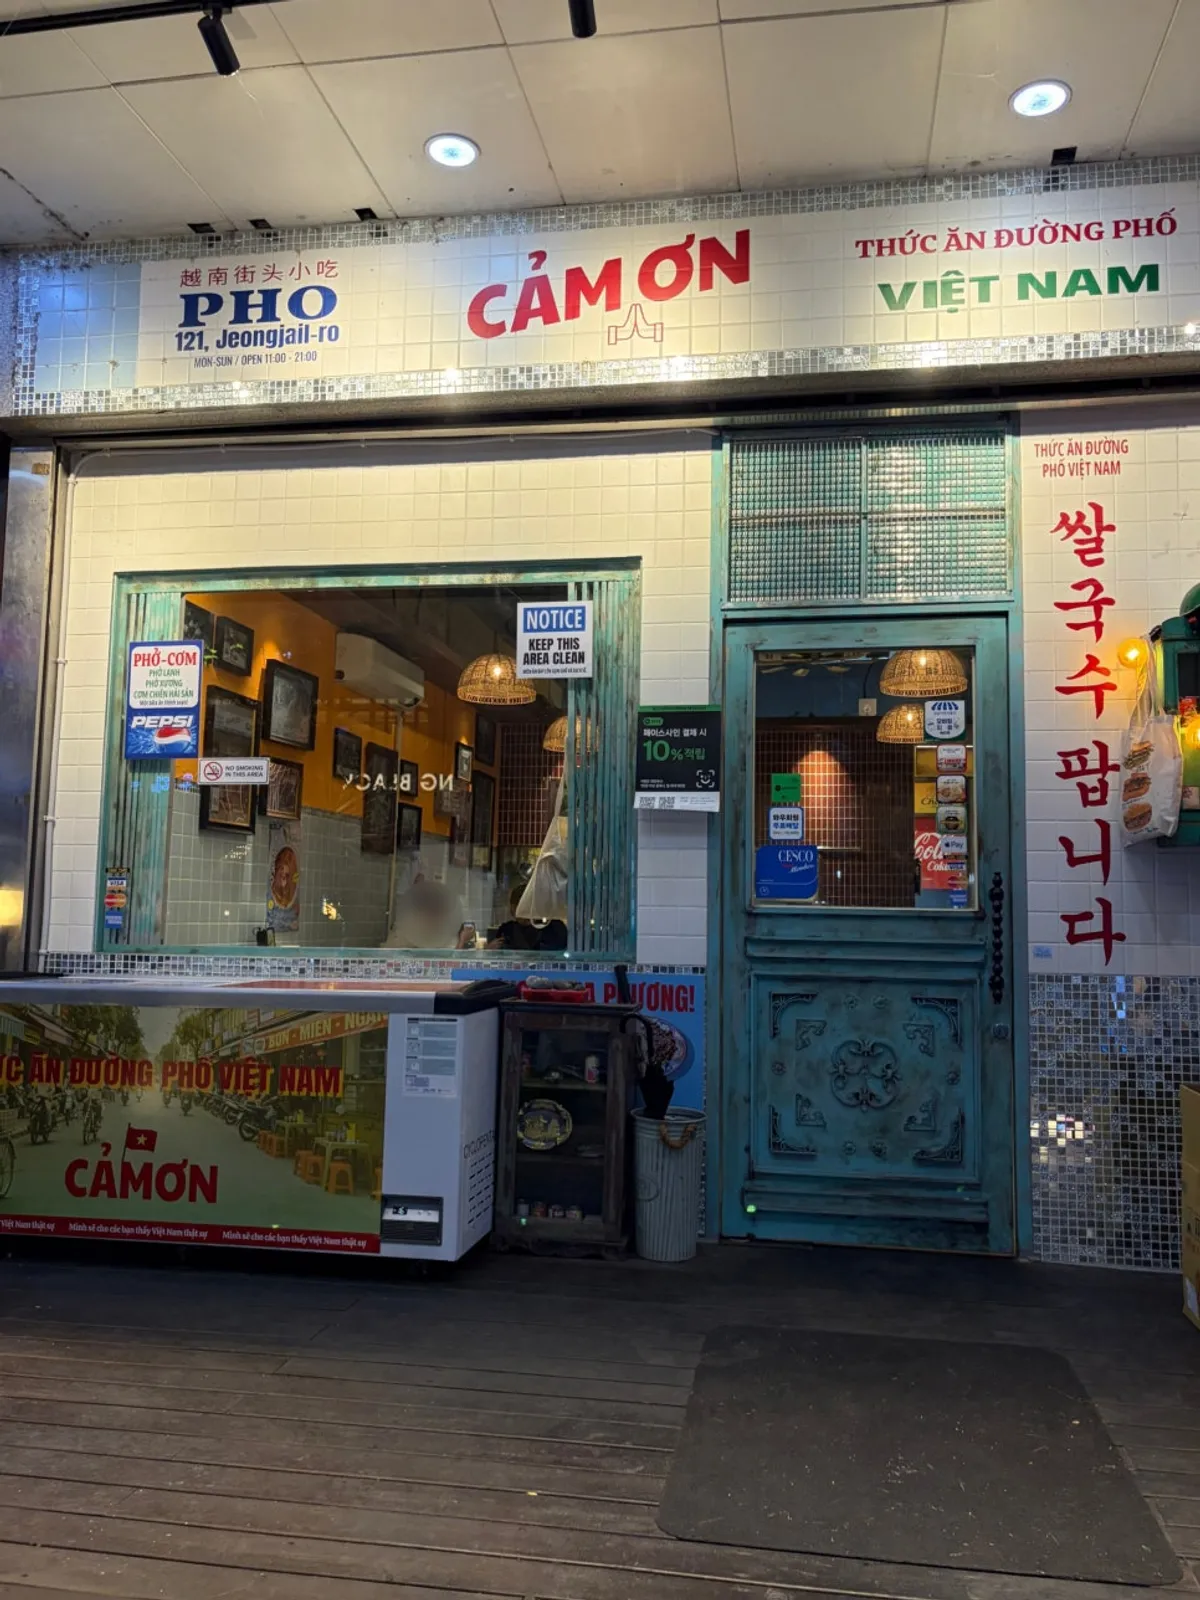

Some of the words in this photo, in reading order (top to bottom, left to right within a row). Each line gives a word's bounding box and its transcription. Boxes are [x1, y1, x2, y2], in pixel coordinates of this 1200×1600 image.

[855, 229, 937, 258] THỨC
[943, 227, 986, 251] ĂN
[993, 218, 1105, 249] ĐƯỜNG
[1112, 207, 1177, 239] PHỐ
[179, 259, 339, 288] 越南街头小吃
[467, 250, 622, 339] CẢM
[637, 229, 750, 302] ƠN
[877, 269, 999, 313] VIỆT
[1017, 263, 1160, 301] NAM
[178, 285, 338, 328] PHO
[175, 330, 209, 352] 121,
[216, 323, 339, 349] Jeongjail-ro
[194, 356, 233, 368] MON-SUN
[241, 353, 262, 366] OPEN
[265, 352, 287, 364] 11:00
[294, 350, 317, 362] 21:00
[1034, 438, 1064, 458] THỨC
[1067, 438, 1083, 456] ĂN
[1085, 436, 1129, 455] ĐƯỜNG
[1042, 458, 1065, 478] PHỐ
[1067, 458, 1091, 480] VIỆT
[1094, 460, 1121, 476] NAM
[526, 608, 583, 630] NOTICE
[1050, 502, 1118, 719] 쌀국수
[528, 638, 554, 651] KEEP
[556, 637, 580, 650] THIS
[523, 652, 549, 665] AREA
[552, 651, 585, 664] CLEAN
[131, 715, 194, 729] PEPSI
[699, 728, 707, 737] 시
[778, 849, 814, 862] CESCO
[950, 840, 964, 850] Pay
[1055, 740, 1127, 967] 팝니다
[219, 1056, 272, 1096] VIỆT
[278, 1064, 343, 1096] NAM
[167, 1228, 182, 1237] Nam
[323, 1237, 340, 1245] Nam
